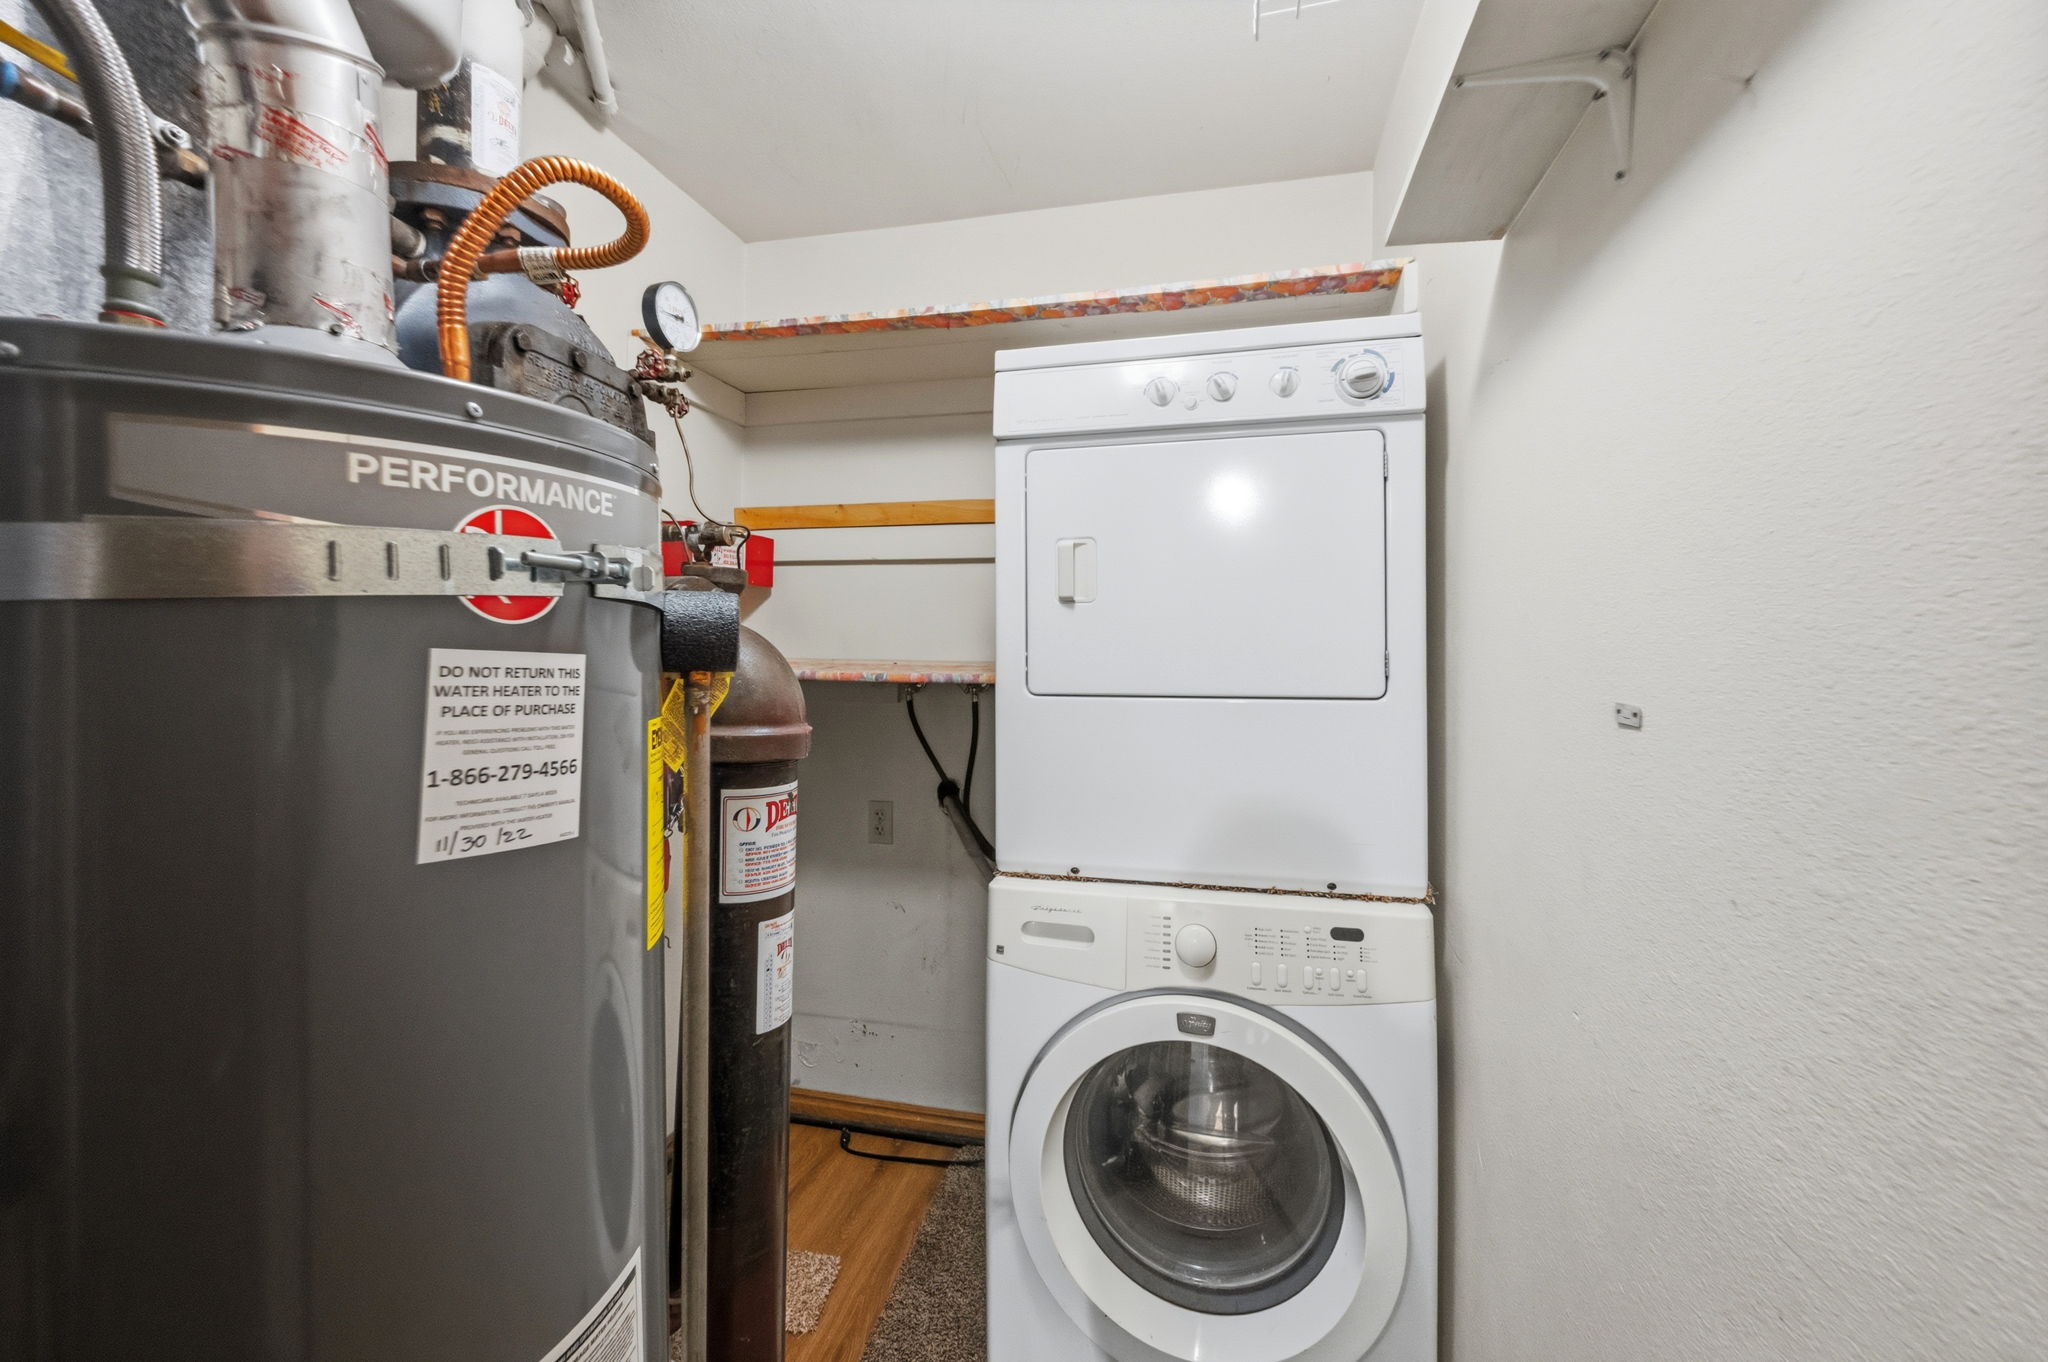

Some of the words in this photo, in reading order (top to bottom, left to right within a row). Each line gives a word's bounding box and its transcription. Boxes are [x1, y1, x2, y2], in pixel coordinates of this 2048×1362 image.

[347, 452, 614, 517] PERFORMANCE
[439, 665, 464, 678] DO
[468, 666, 501, 678] NOT
[505, 667, 555, 679] RETURN
[558, 668, 581, 679] THIS
[433, 685, 489, 697] WATER
[492, 685, 543, 697] HEATER
[545, 685, 560, 696] TO
[562, 685, 580, 697] THE
[440, 705, 489, 717] PLACE
[492, 704, 512, 717] OF
[515, 703, 576, 716] PURCHASE
[427, 758, 578, 788] 1-866-279-4566
